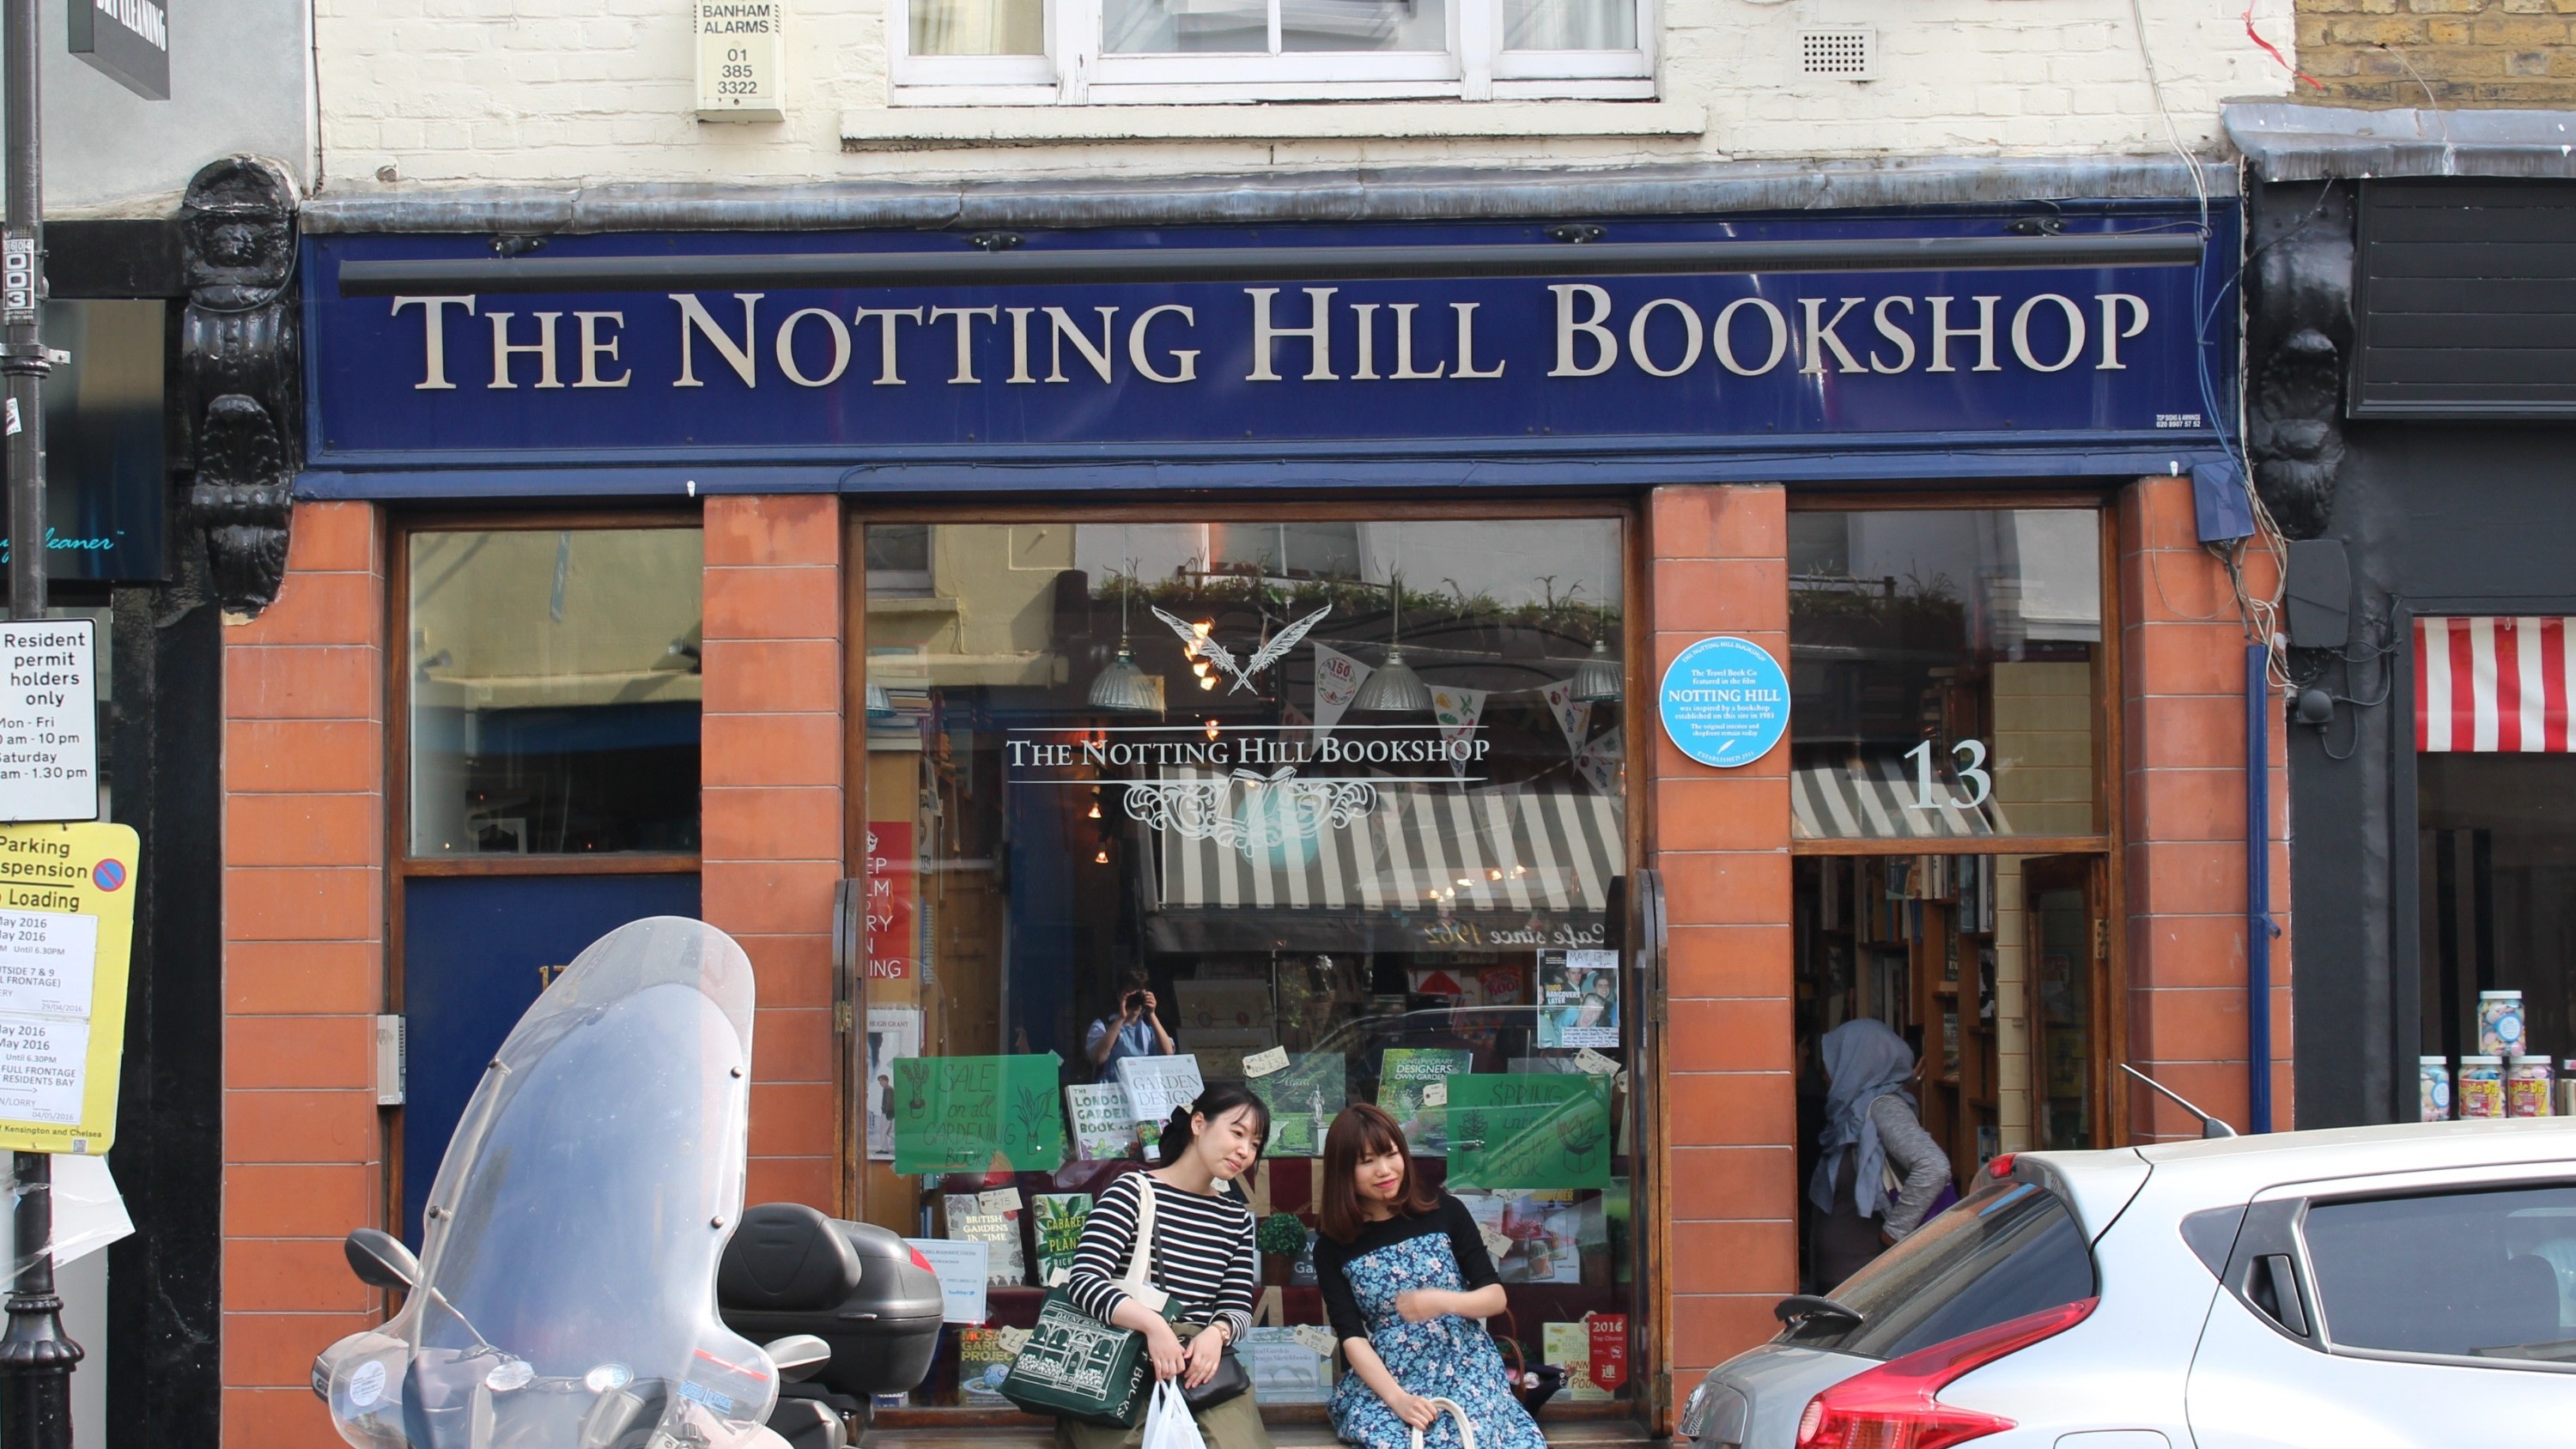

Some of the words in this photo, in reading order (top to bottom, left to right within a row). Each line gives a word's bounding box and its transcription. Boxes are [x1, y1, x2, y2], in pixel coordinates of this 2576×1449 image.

[702, 3, 770, 18] BANHAM
[703, 20, 769, 33] ALARMS
[726, 48, 747, 62] 01
[721, 64, 753, 78] 385
[717, 81, 757, 94] 3322
[392, 294, 632, 390] THE
[668, 293, 1201, 389] NOTTING
[1243, 287, 1506, 382] HILL
[1546, 282, 2151, 379] BOOKSHOP
[4, 633, 86, 647] Resident
[14, 652, 76, 669] permit
[1332, 658, 1351, 677] 150
[10, 671, 81, 686] holders
[26, 691, 64, 706] only
[1668, 689, 1741, 702] NOTTING
[1745, 689, 1782, 702] HILL
[1736, 704, 1771, 712] bookshop
[36, 717, 55, 727] Fri
[7, 735, 27, 743] am
[39, 733, 55, 743] 10
[58, 734, 80, 745] pm
[1006, 739, 1073, 767] THE
[1079, 738, 1229, 767] NOTTING
[1237, 737, 1312, 765] HILL
[1320, 736, 1491, 765] BOOKSHOP
[2, 770, 21, 779] am
[33, 767, 63, 779] 1.30
[67, 768, 88, 779] pm
[1904, 739, 1991, 809] 13
[9, 888, 80, 912] Loading
[19, 918, 47, 928] 2016
[18, 931, 46, 942] 2016
[34, 947, 65, 955] 6.30PM
[30, 967, 36, 976] 7
[39, 968, 46, 977] &
[7, 976, 62, 988] FRONTAGE)
[18, 1025, 46, 1037] 2016
[22, 1039, 51, 1051] 2016
[6, 1053, 25, 1063] Until
[27, 1055, 57, 1064] 6.30PM
[2, 1064, 23, 1075] FULL
[25, 1066, 76, 1078] FRONTAGE
[3, 1075, 53, 1086] RESIDENTS
[56, 1077, 75, 1088] BAY
[939, 1063, 997, 1093] SALE
[1133, 1075, 1200, 1090] GARDEN
[1075, 1094, 1129, 1106] LONDON
[4, 1125, 50, 1136] Kensington
[70, 1129, 102, 1138] Chelsea
[923, 1122, 1017, 1146] GARDENING
[1080, 1122, 1115, 1133] BOOK
[966, 1215, 1003, 1224] BRITISH
[1048, 1216, 1086, 1231] CABARET
[963, 1223, 1008, 1233] GARDENS
